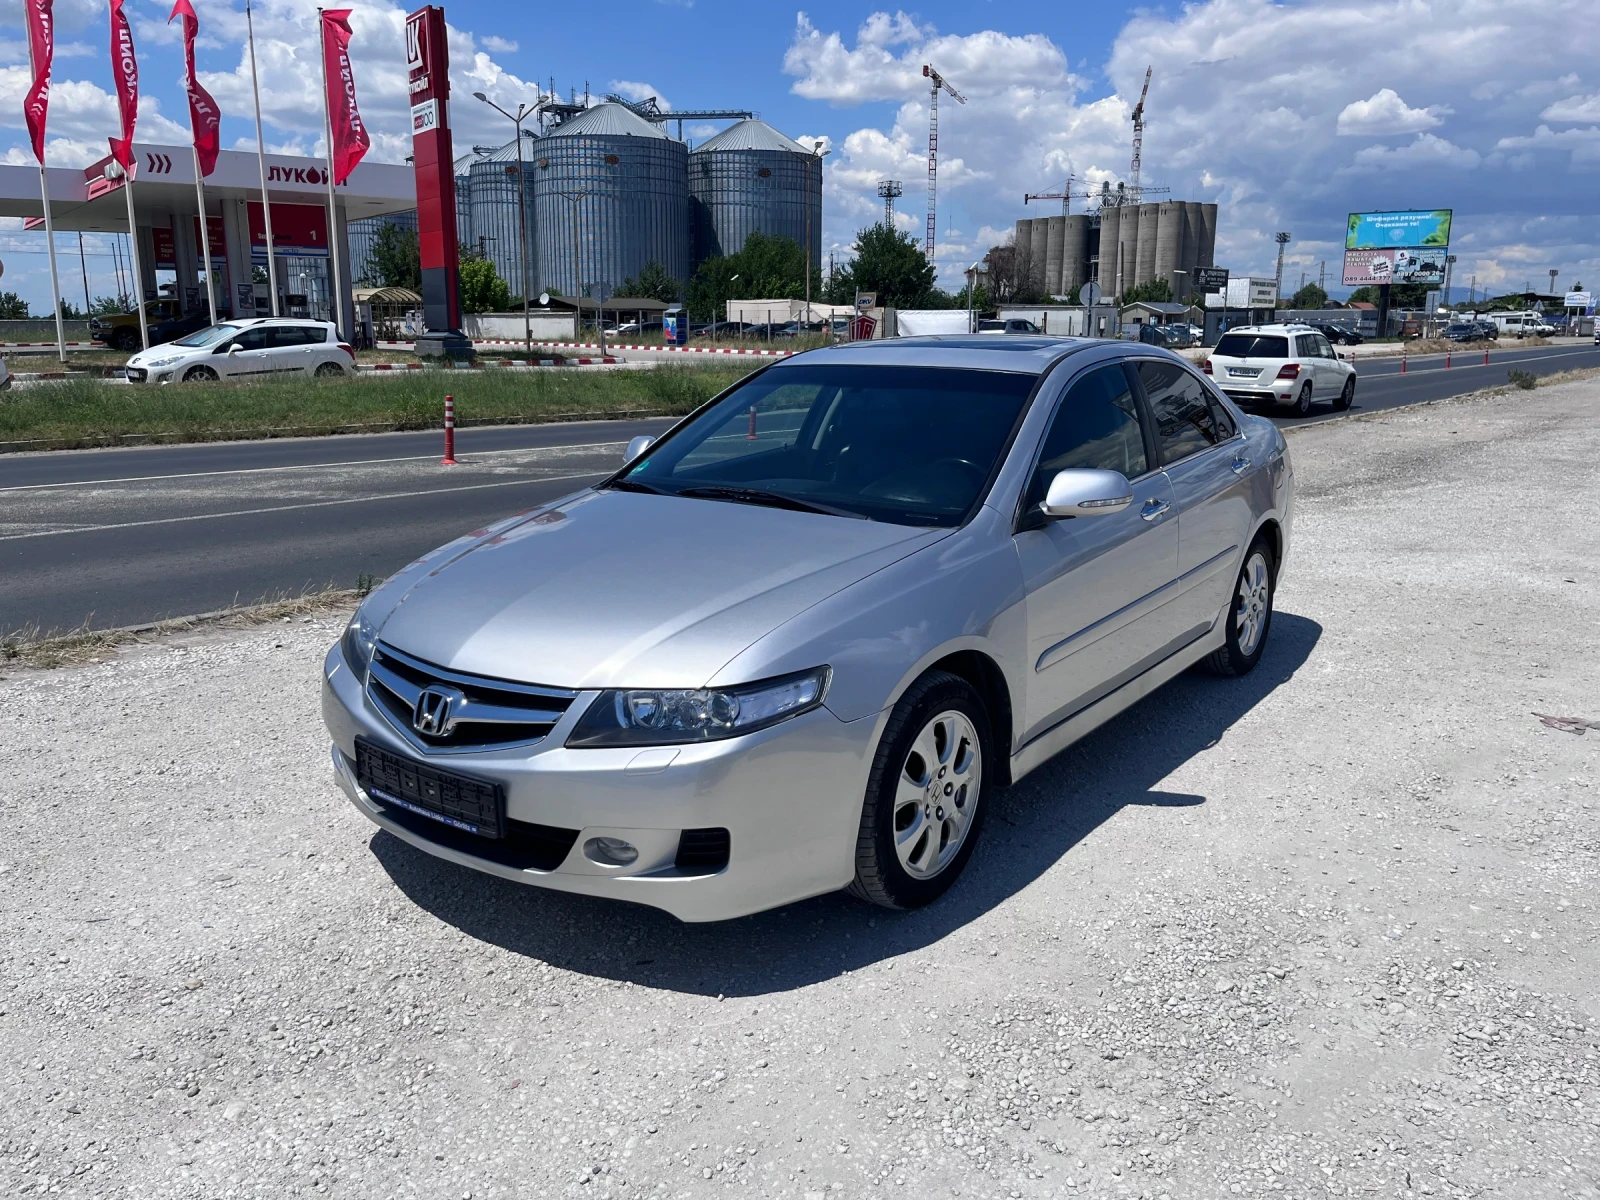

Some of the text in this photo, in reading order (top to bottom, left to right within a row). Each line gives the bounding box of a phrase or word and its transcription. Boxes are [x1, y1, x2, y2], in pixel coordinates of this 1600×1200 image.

[268, 166, 347, 186] ЛУКОЙ
[1400, 213, 1432, 222] разумно!
[309, 230, 317, 240] 1
[408, 803, 431, 818] Autohaus
[453, 820, 471, 832] Görlitz
